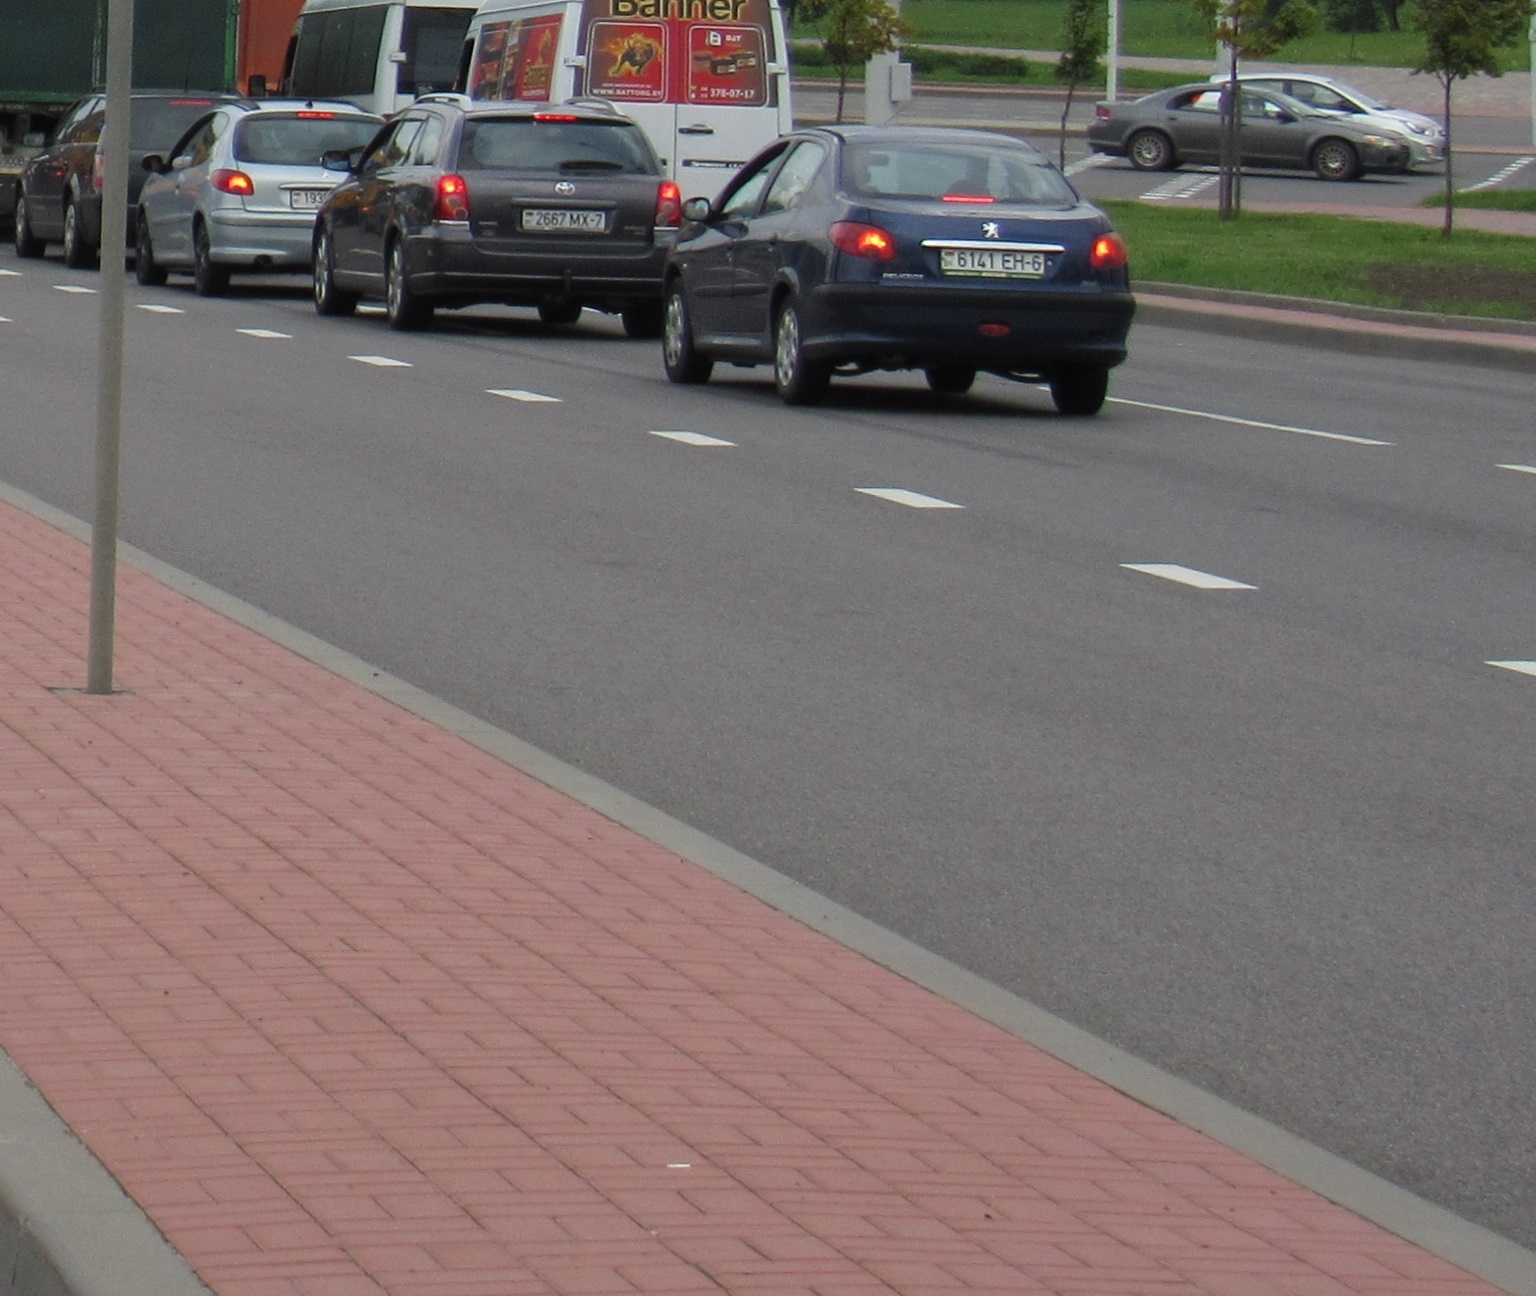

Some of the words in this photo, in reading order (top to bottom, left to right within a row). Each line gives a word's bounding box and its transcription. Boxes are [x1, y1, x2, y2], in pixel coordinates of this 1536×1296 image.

[536, 212, 566, 226] 2667
[569, 213, 603, 227] MX-7
[957, 251, 995, 269] 6141
[1001, 253, 1043, 271] EH-6
